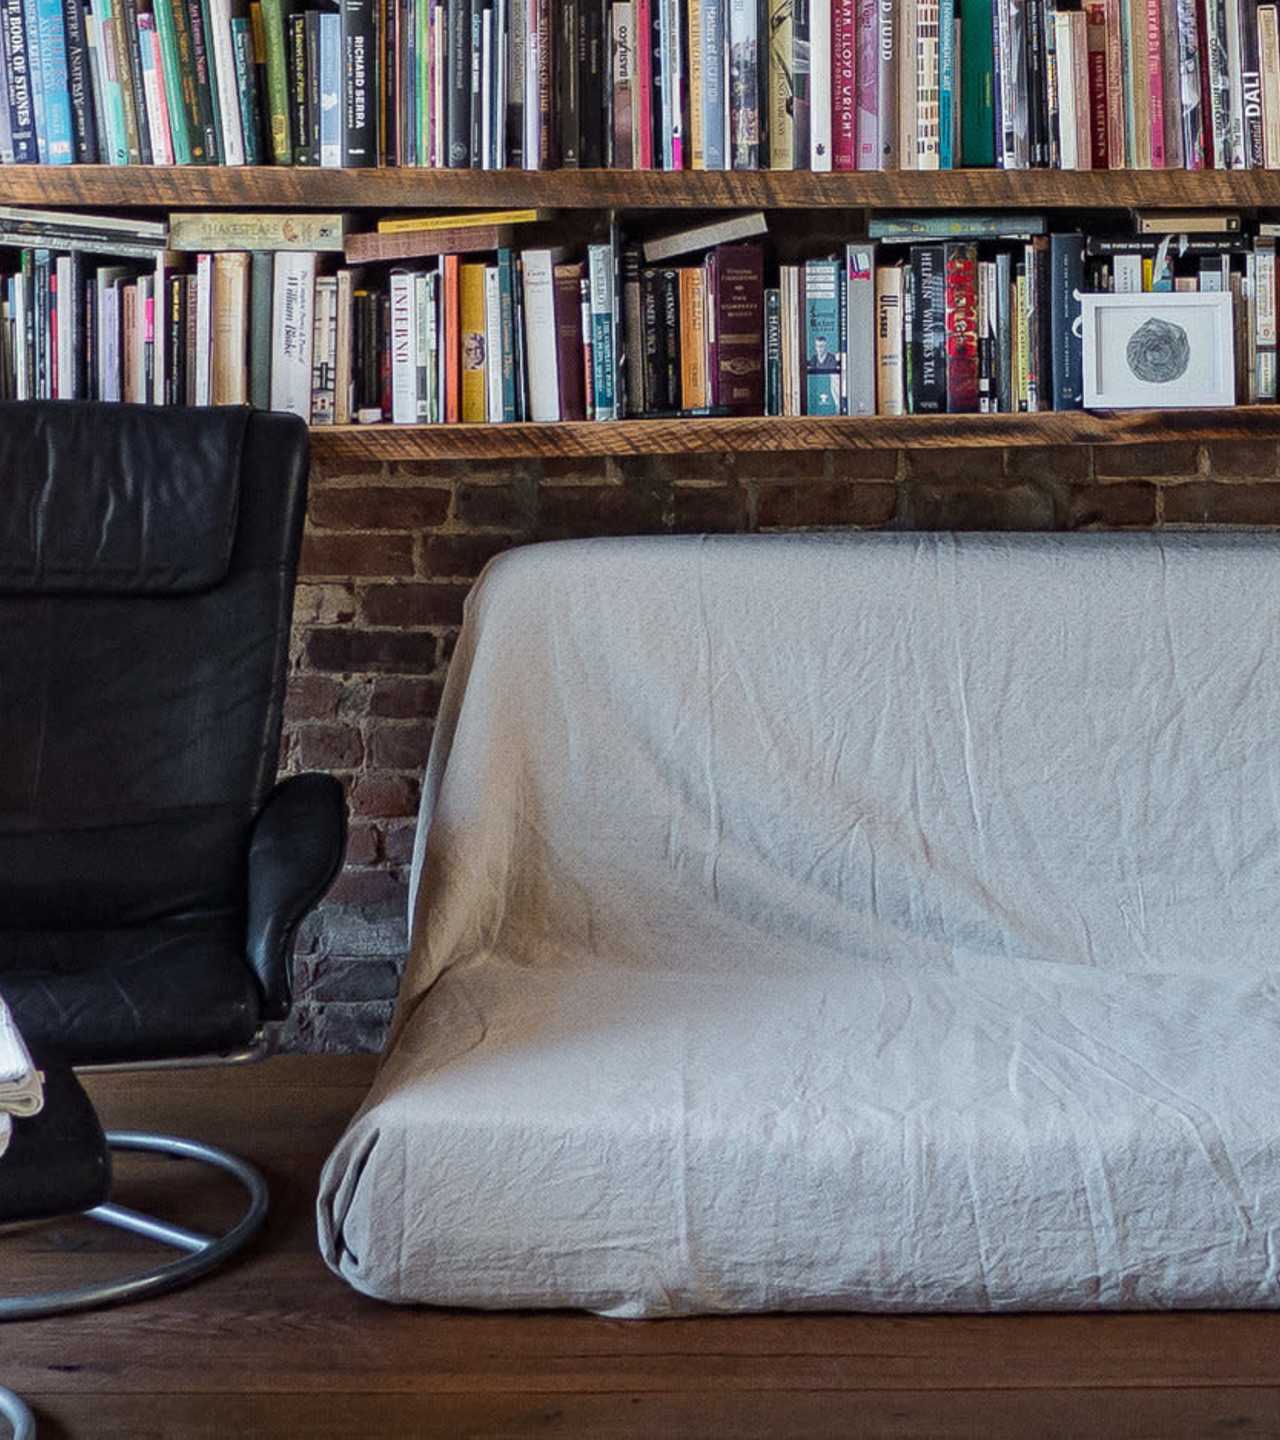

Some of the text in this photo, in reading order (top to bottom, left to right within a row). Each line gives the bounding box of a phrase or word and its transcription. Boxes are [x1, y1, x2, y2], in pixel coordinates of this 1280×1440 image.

[8, 17, 23, 52] BOOK
[882, 17, 893, 62] JUDD
[10, 56, 25, 70] OF
[354, 36, 365, 129] RICHARD SERRA
[12, 72, 30, 126] STONES
[1243, 71, 1261, 117] DALI
[394, 284, 409, 363] INFERNO
[767, 315, 779, 360] HAMLET
